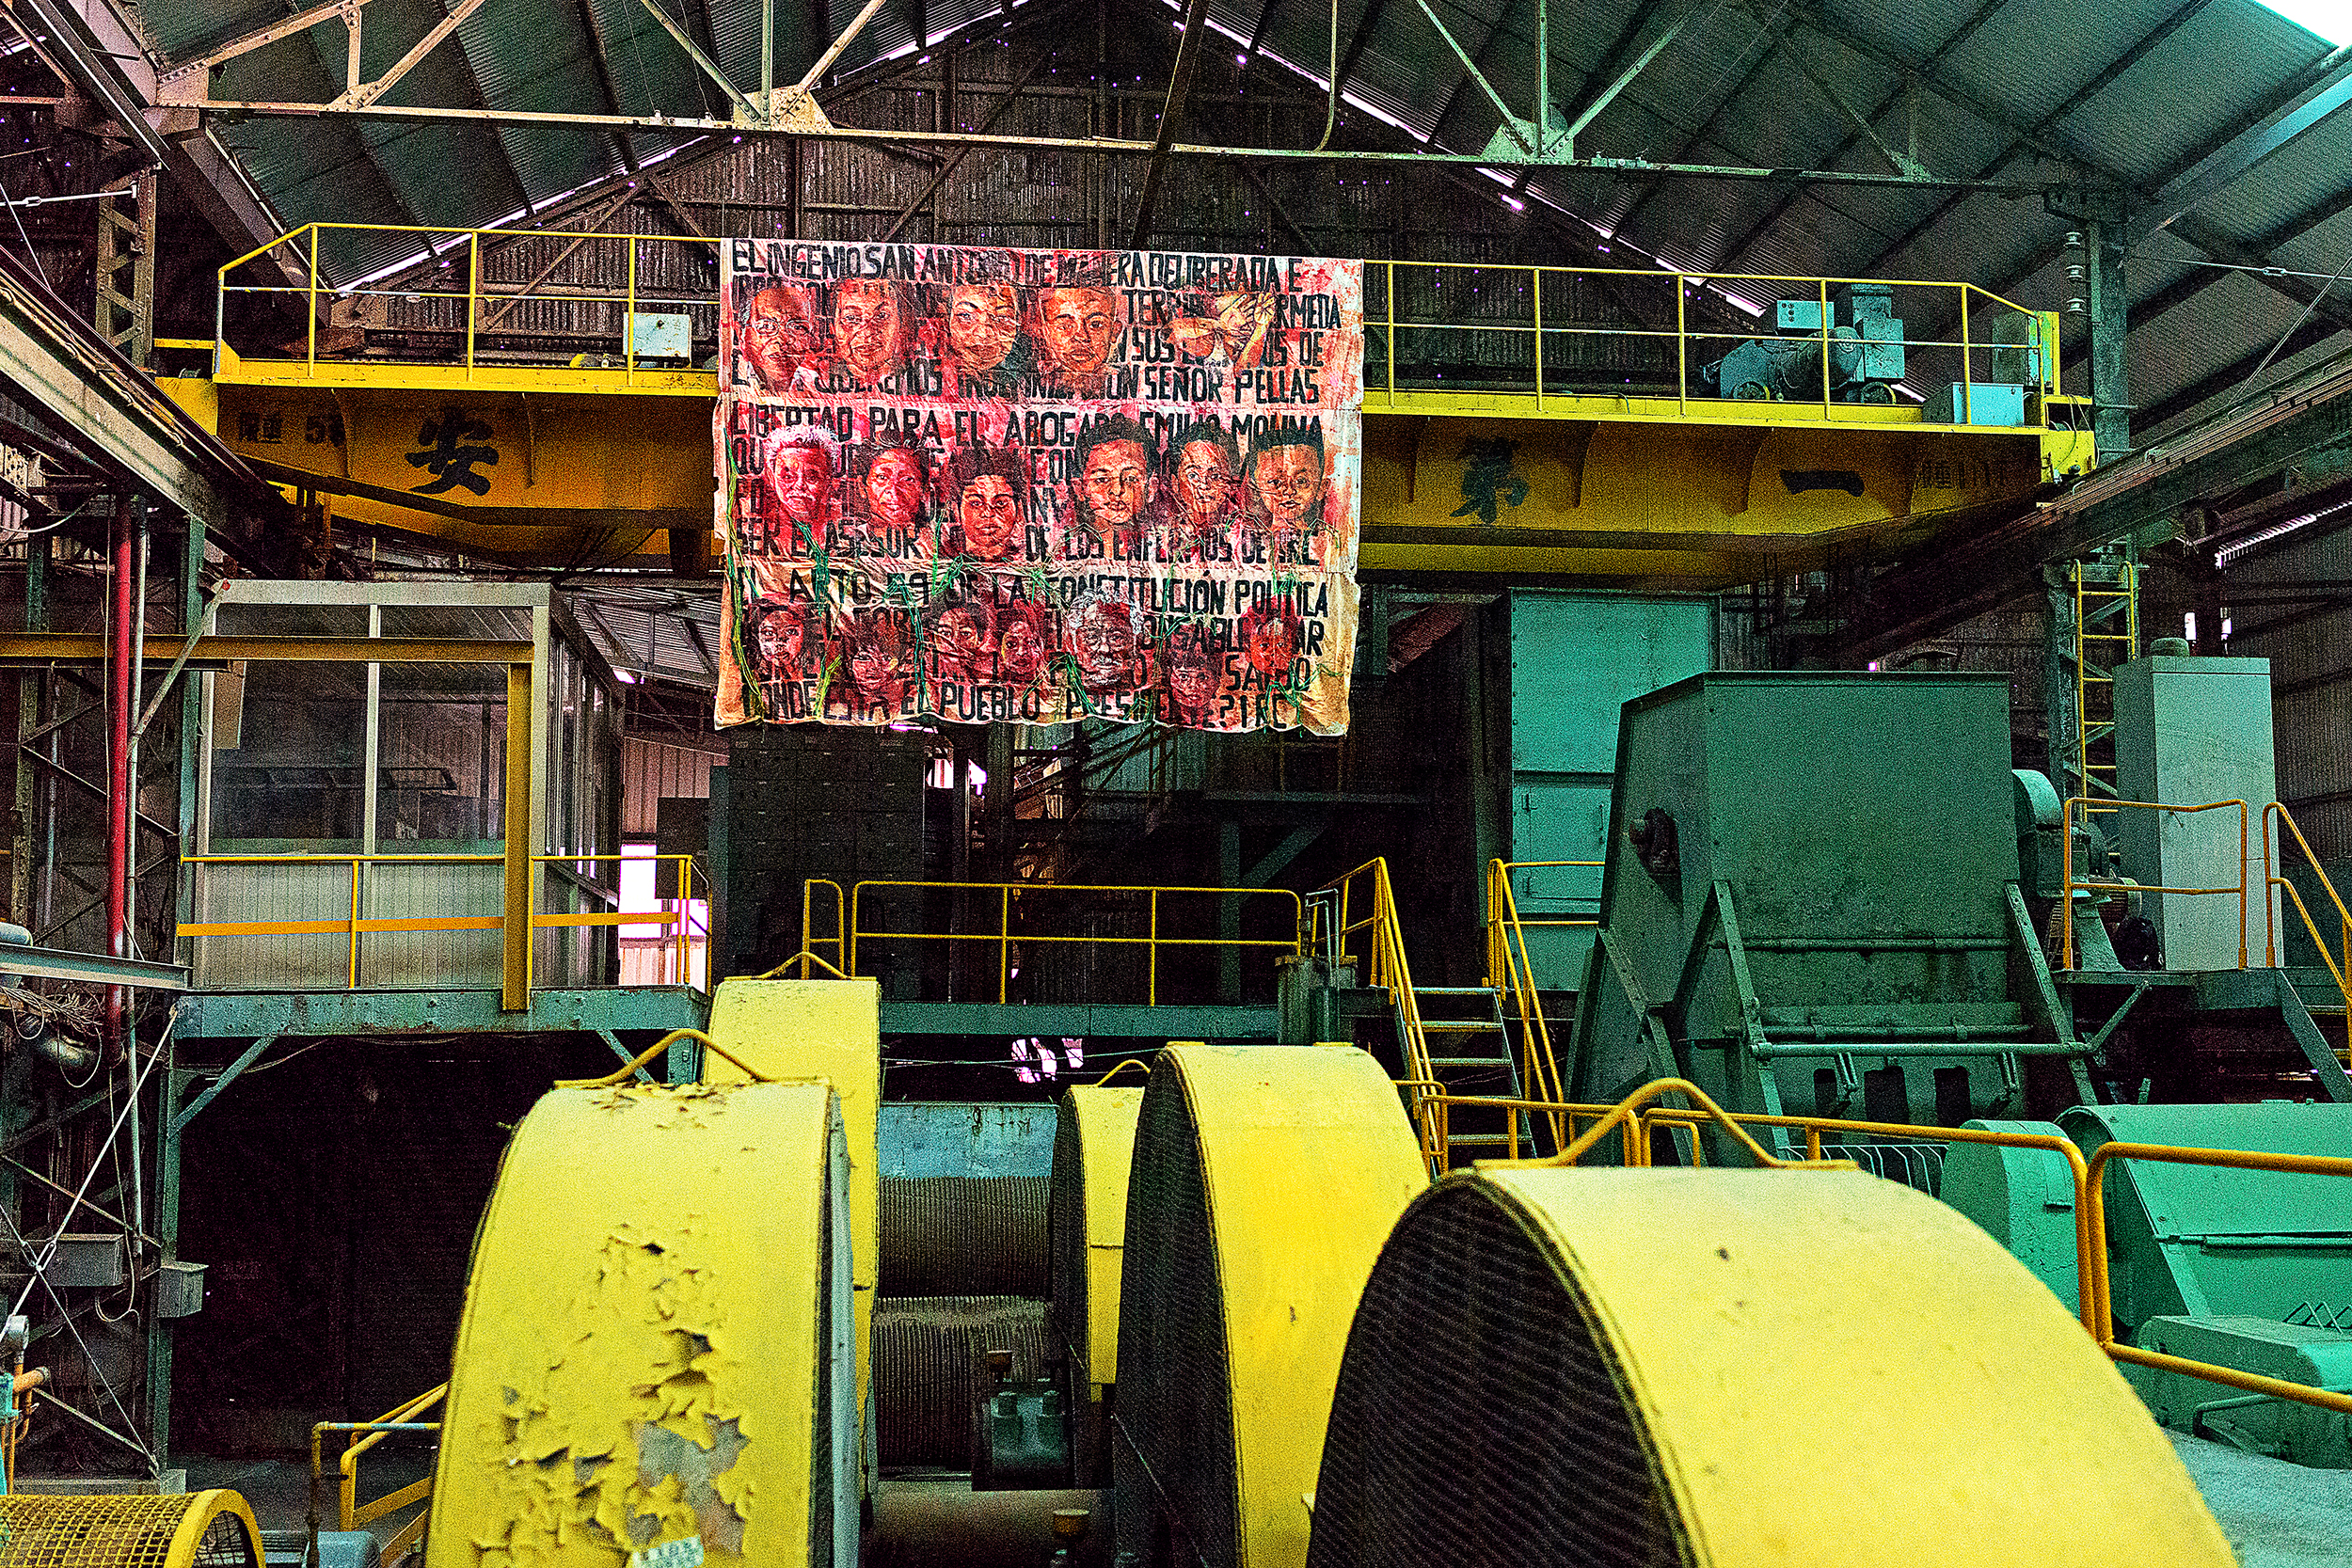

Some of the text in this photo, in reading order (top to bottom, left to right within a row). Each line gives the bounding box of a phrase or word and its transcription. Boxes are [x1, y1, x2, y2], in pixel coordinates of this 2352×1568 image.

[733, 239, 766, 273] EL
[768, 242, 861, 279] INGENIO
[864, 245, 916, 281] SAN
[1299, 331, 1325, 367] DE
[1144, 363, 1223, 403] SEÑOR
[1234, 368, 1320, 404] PELLAS
[869, 406, 943, 447] PARA
[955, 410, 986, 448] EL
[736, 516, 781, 556] SER
[941, 683, 1041, 722] PUEBLO
